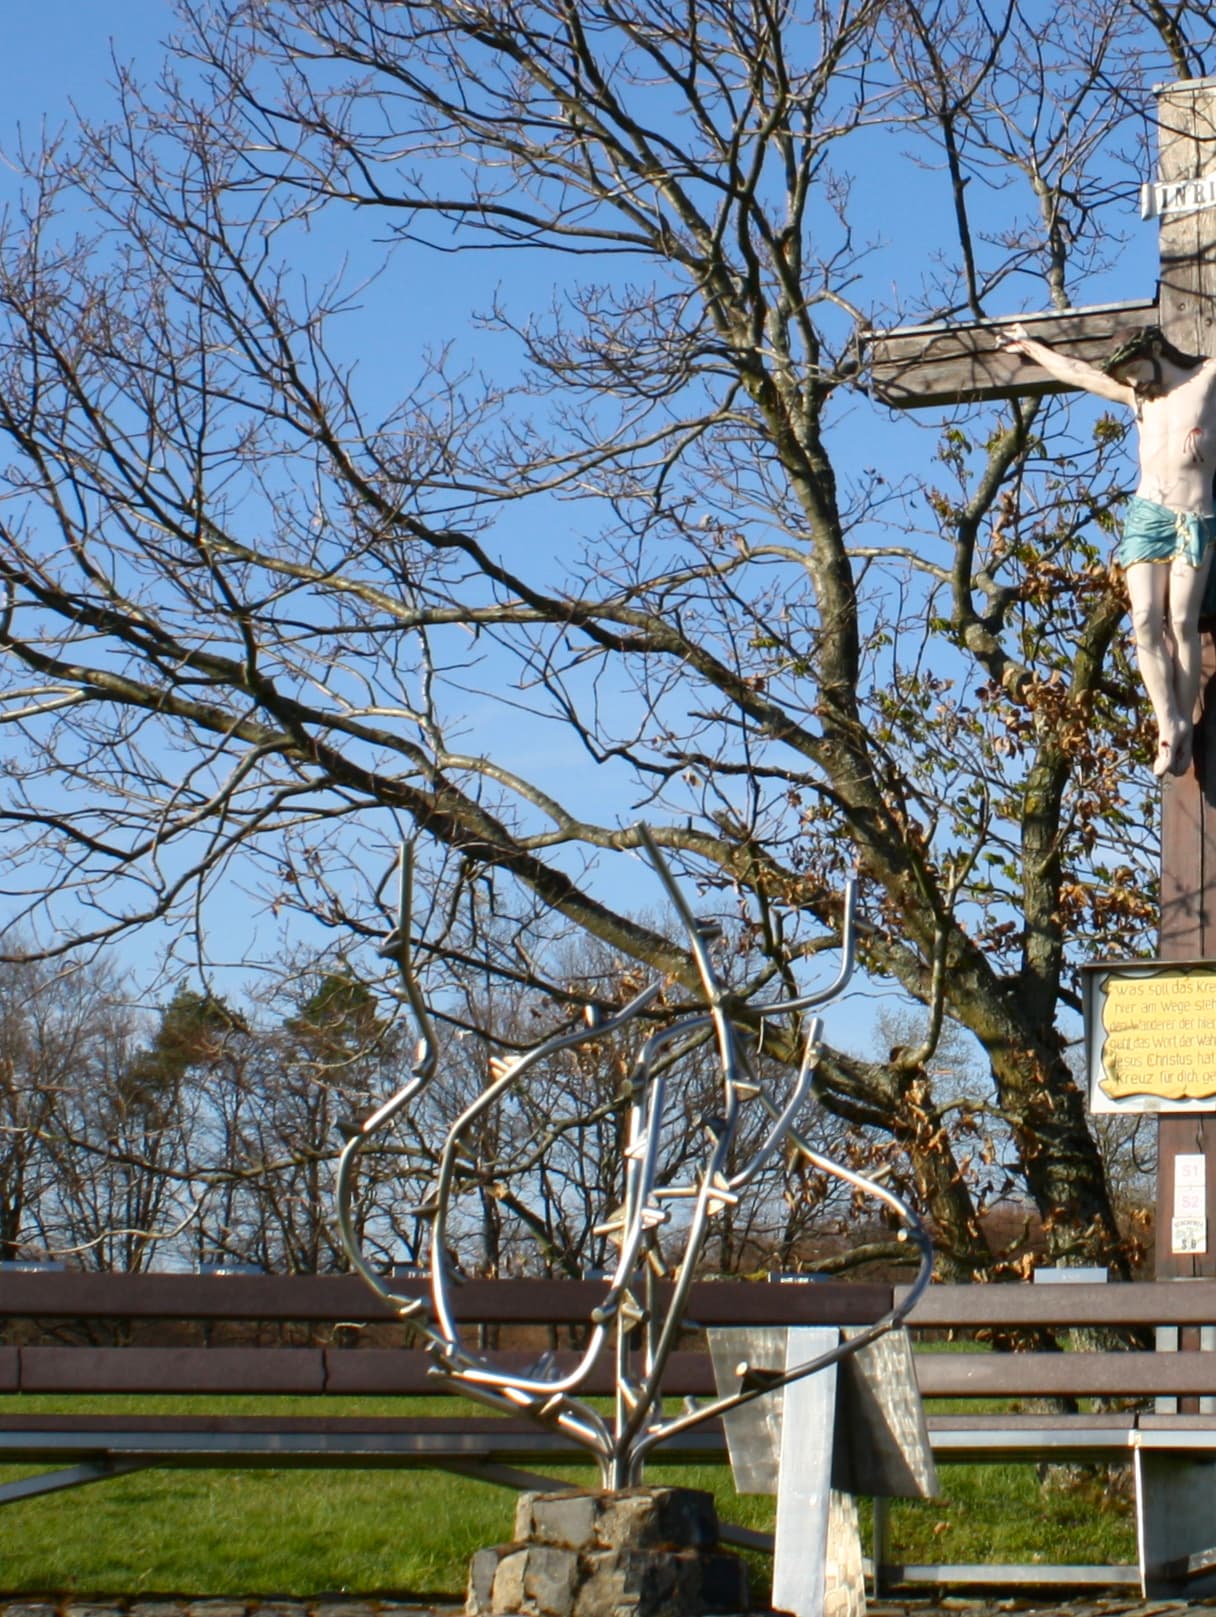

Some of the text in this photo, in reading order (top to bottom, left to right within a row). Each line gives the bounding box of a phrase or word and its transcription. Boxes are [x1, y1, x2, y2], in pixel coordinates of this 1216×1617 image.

[1161, 181, 1215, 208] INRI
[1148, 982, 1169, 996] soll
[1172, 980, 1193, 994] das
[1140, 1002, 1157, 1013] am
[1160, 999, 1191, 1014] Wege
[1179, 1017, 1194, 1029] der
[1197, 1014, 1215, 1028] hier
[1151, 1034, 1178, 1048] Wort
[1114, 1053, 1143, 1068] Jesus
[1146, 1052, 1193, 1067] Christus
[1197, 1050, 1215, 1064] hat
[1115, 1071, 1154, 1085] Kreuz
[1160, 1070, 1174, 1084] für
[1177, 1069, 1199, 1083] dich
